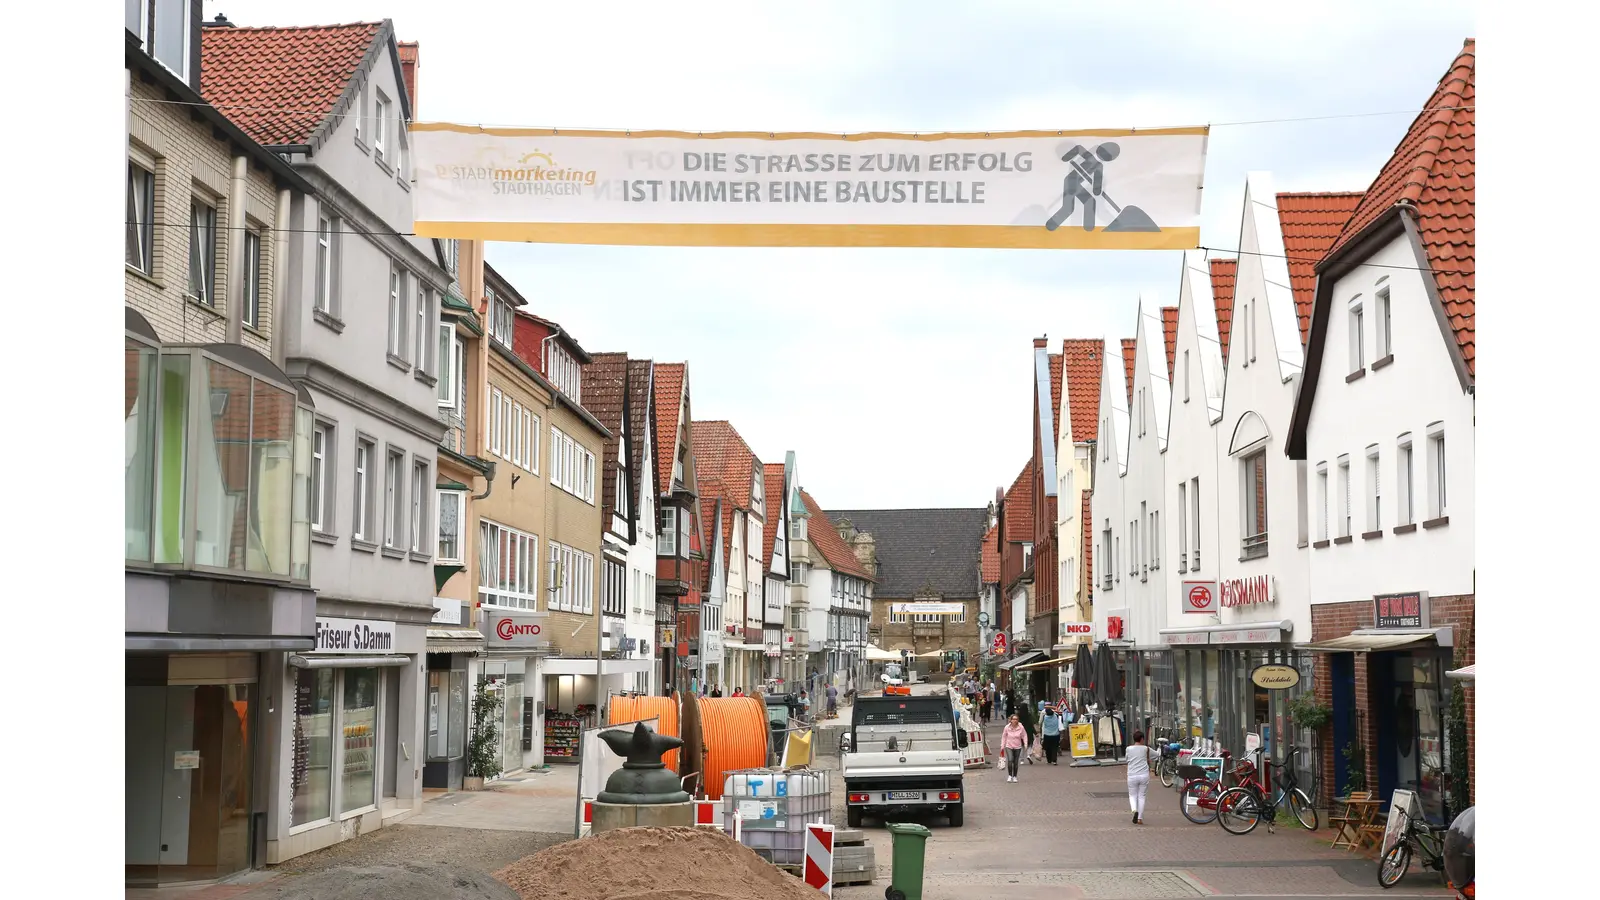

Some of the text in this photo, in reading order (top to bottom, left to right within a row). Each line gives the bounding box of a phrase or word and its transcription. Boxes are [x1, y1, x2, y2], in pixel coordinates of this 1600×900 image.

[683, 151, 1033, 174] DIE STRASSE ZUM ERFOLG
[492, 181, 582, 196] STADTHAGEN
[623, 180, 985, 204] IST IMMER EINE BAUSTELLE
[1220, 574, 1269, 608] ROSSMANN
[315, 622, 391, 650] Friseur S.Damm
[496, 618, 541, 641] CANTO
[1066, 625, 1091, 633] NKD
[747, 780, 764, 797] T
